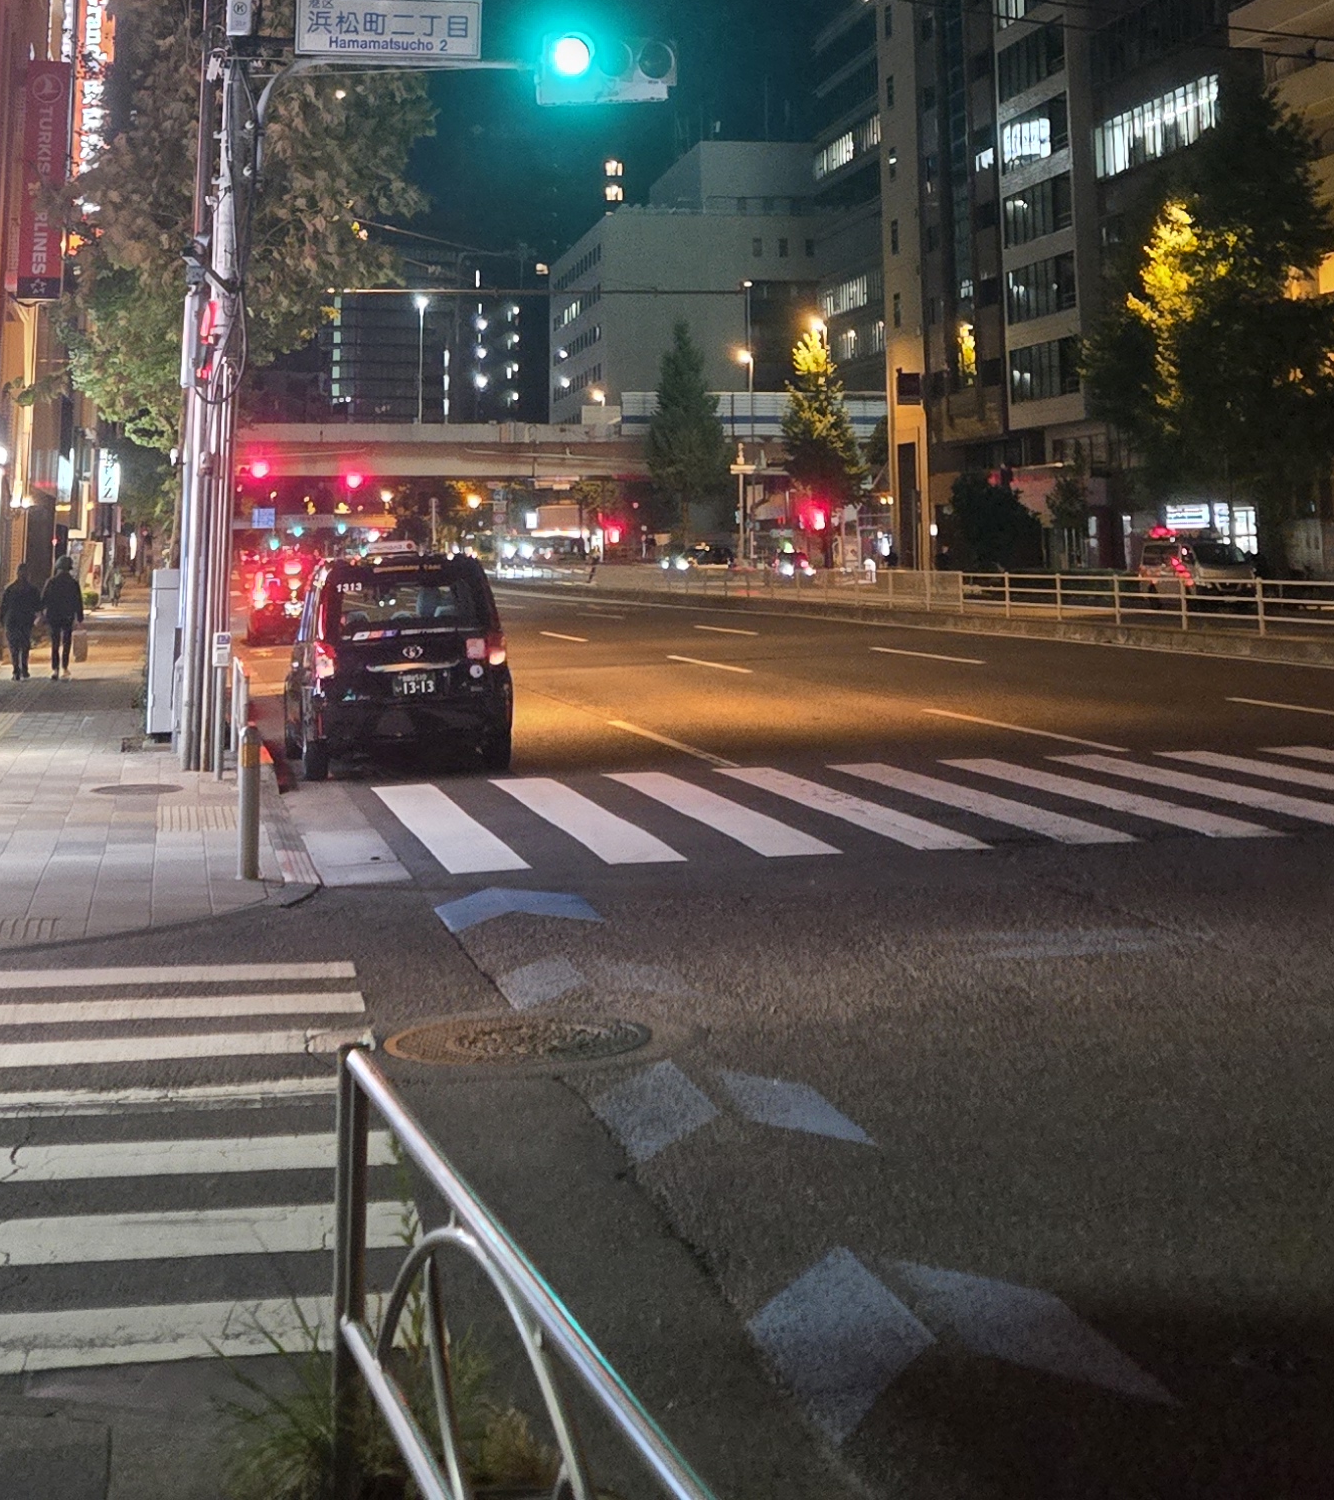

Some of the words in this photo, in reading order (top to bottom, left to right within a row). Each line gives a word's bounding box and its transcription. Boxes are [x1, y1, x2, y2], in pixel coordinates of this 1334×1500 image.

[307, 10, 469, 38] 浜松町二丁目
[328, 36, 434, 52] Hamamatsucho
[439, 39, 449, 52] 2
[36, 105, 54, 182] TURKIS
[336, 582, 363, 593] 1313
[403, 680, 435, 695] 13-13
